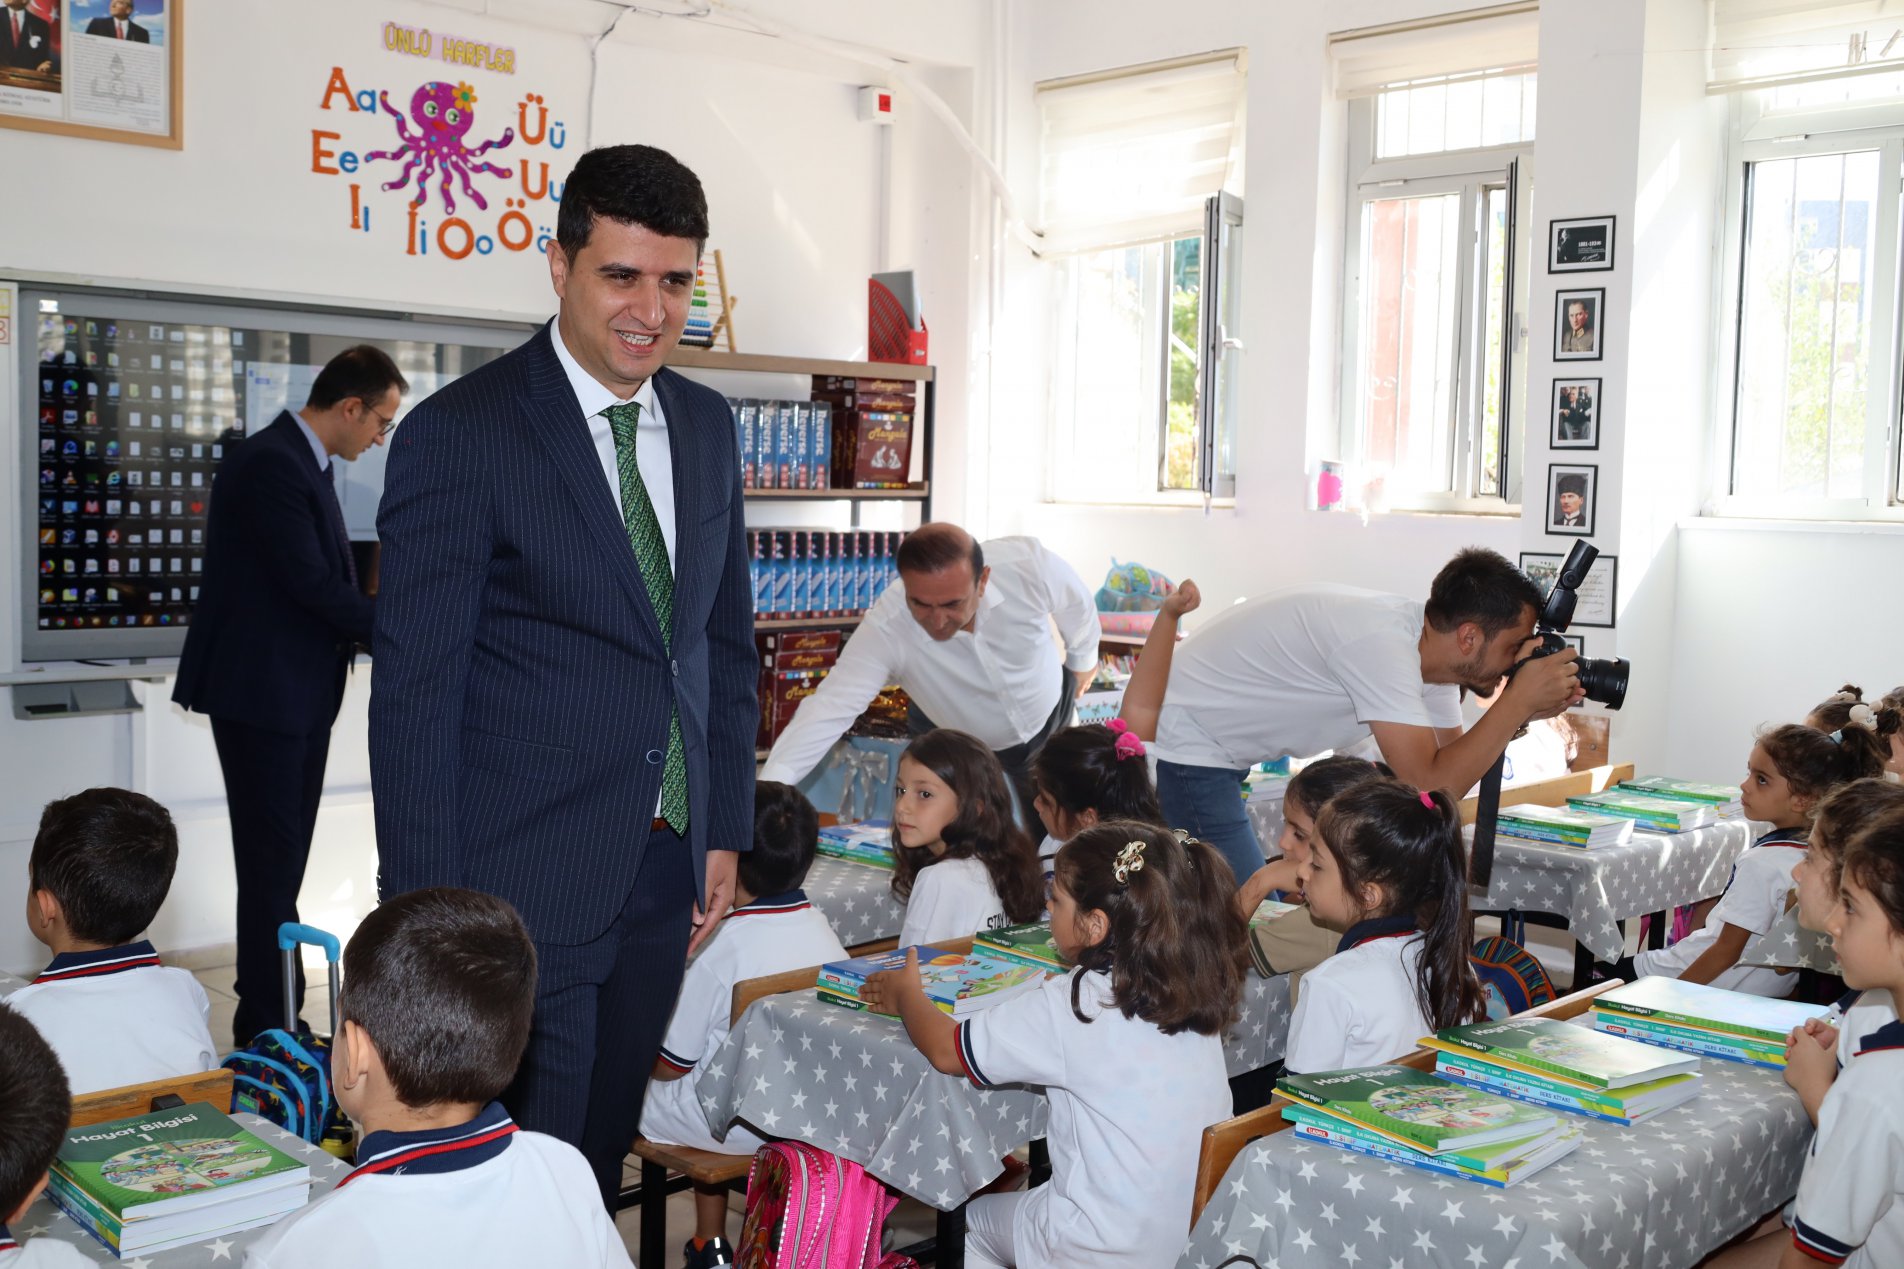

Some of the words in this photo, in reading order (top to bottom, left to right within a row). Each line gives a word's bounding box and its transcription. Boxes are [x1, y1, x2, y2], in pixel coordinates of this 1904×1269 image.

[385, 22, 432, 57] ÜNLÜ
[442, 37, 515, 74] HARFLER
[321, 67, 376, 114] Aa
[311, 129, 359, 175] Ee
[744, 406, 756, 454] Reverse
[780, 408, 792, 455] Reverse
[798, 409, 810, 456] Reverse
[816, 409, 828, 456] Reverse
[868, 427, 908, 442] Mangala
[795, 637, 826, 648] Mangala
[792, 655, 824, 666] Mangala
[1471, 1024, 1508, 1036] Hayat
[1313, 1072, 1360, 1086] Hayat
[1358, 1068, 1402, 1078] Bilgisi
[70, 1128, 136, 1144] Hayat
[139, 1114, 198, 1132] Bilgisi
[137, 1133, 154, 1142] 1
[1308, 1128, 1327, 1138] İLKOKUL
